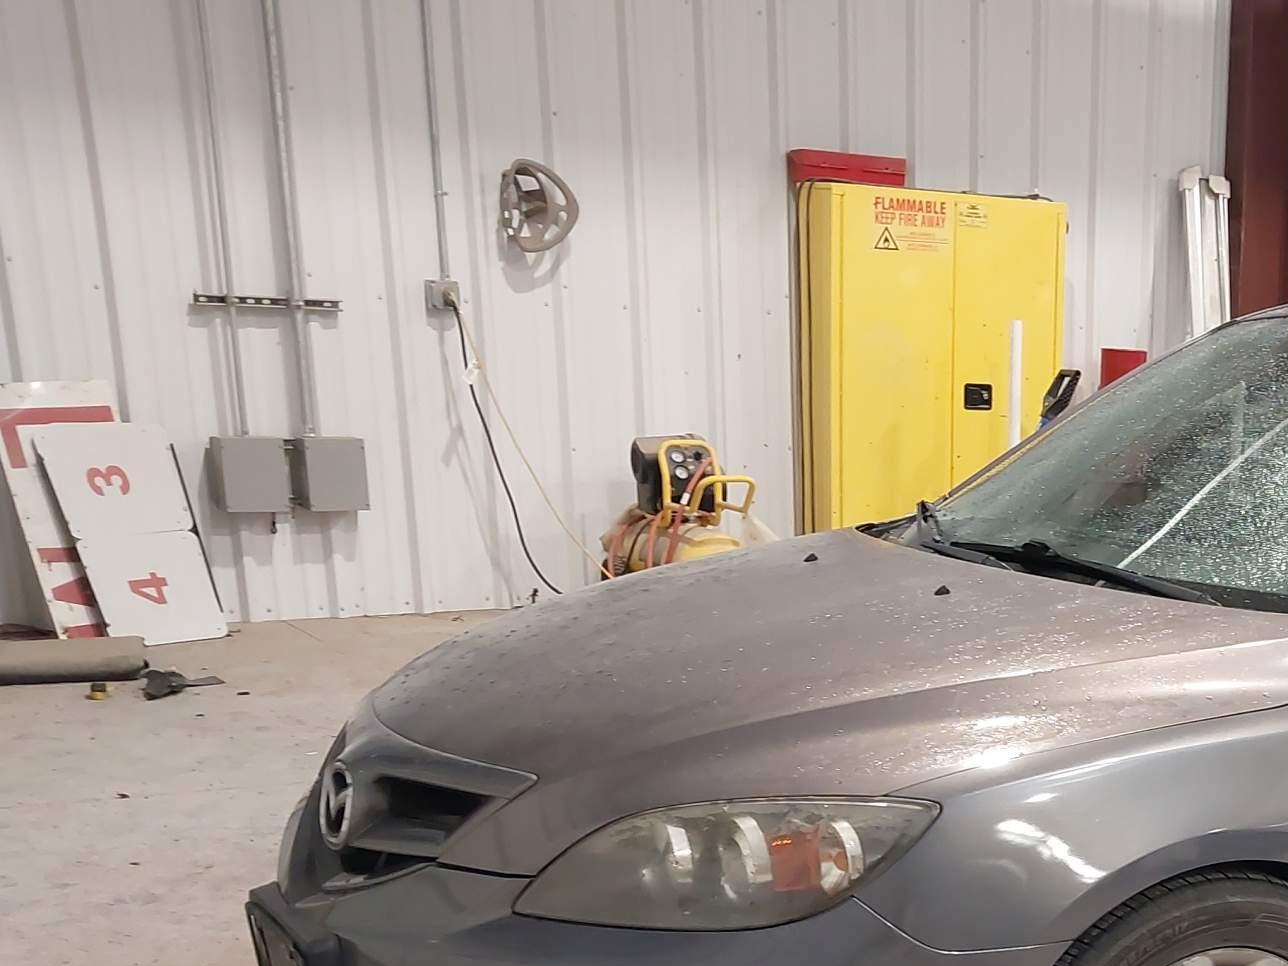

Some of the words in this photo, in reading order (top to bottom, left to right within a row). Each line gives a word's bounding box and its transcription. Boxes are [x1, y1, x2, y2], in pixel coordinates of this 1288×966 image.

[873, 196, 947, 215] FLAMMABLE
[875, 211, 896, 225] KEEP
[899, 213, 918, 227] FIRE
[920, 215, 945, 229] AWAY
[86, 464, 131, 497] 3
[127, 571, 169, 605] 4
